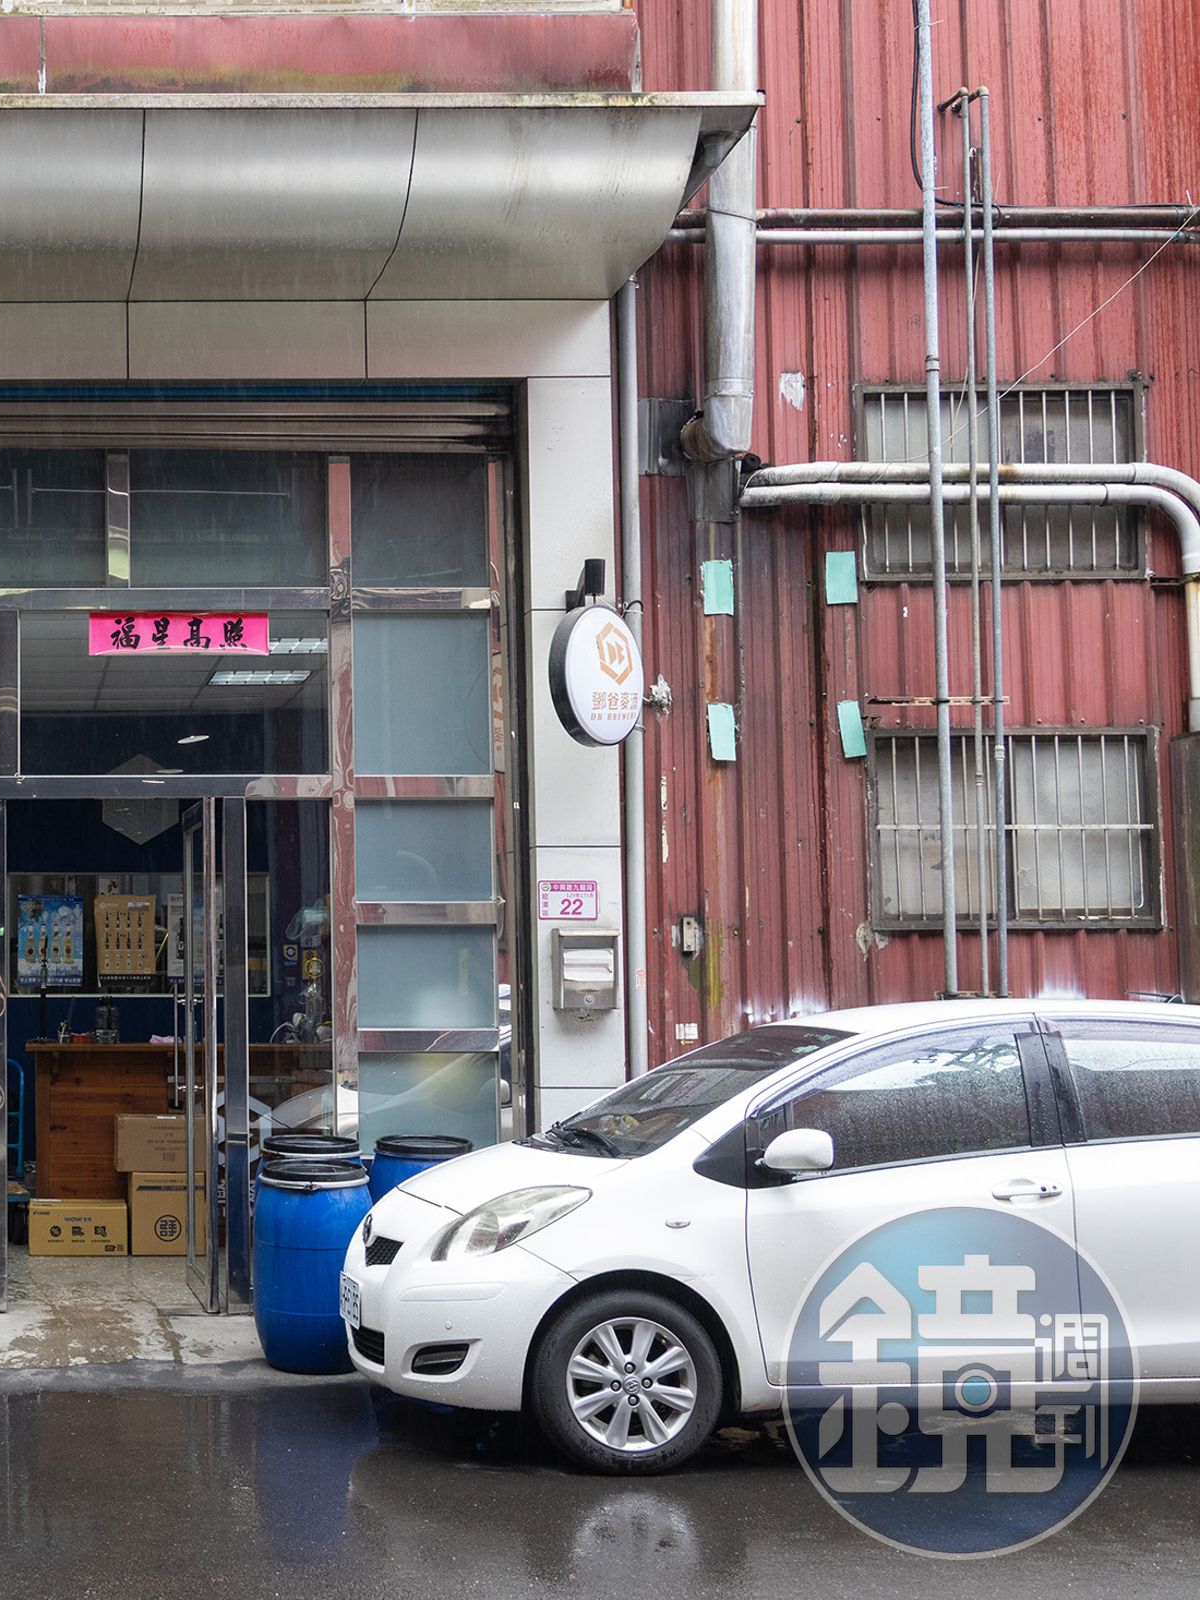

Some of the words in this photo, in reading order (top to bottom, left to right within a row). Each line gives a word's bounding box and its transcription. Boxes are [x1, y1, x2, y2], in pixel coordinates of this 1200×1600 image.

[111, 616, 248, 650] 福星高照
[560, 898, 584, 915] 22
